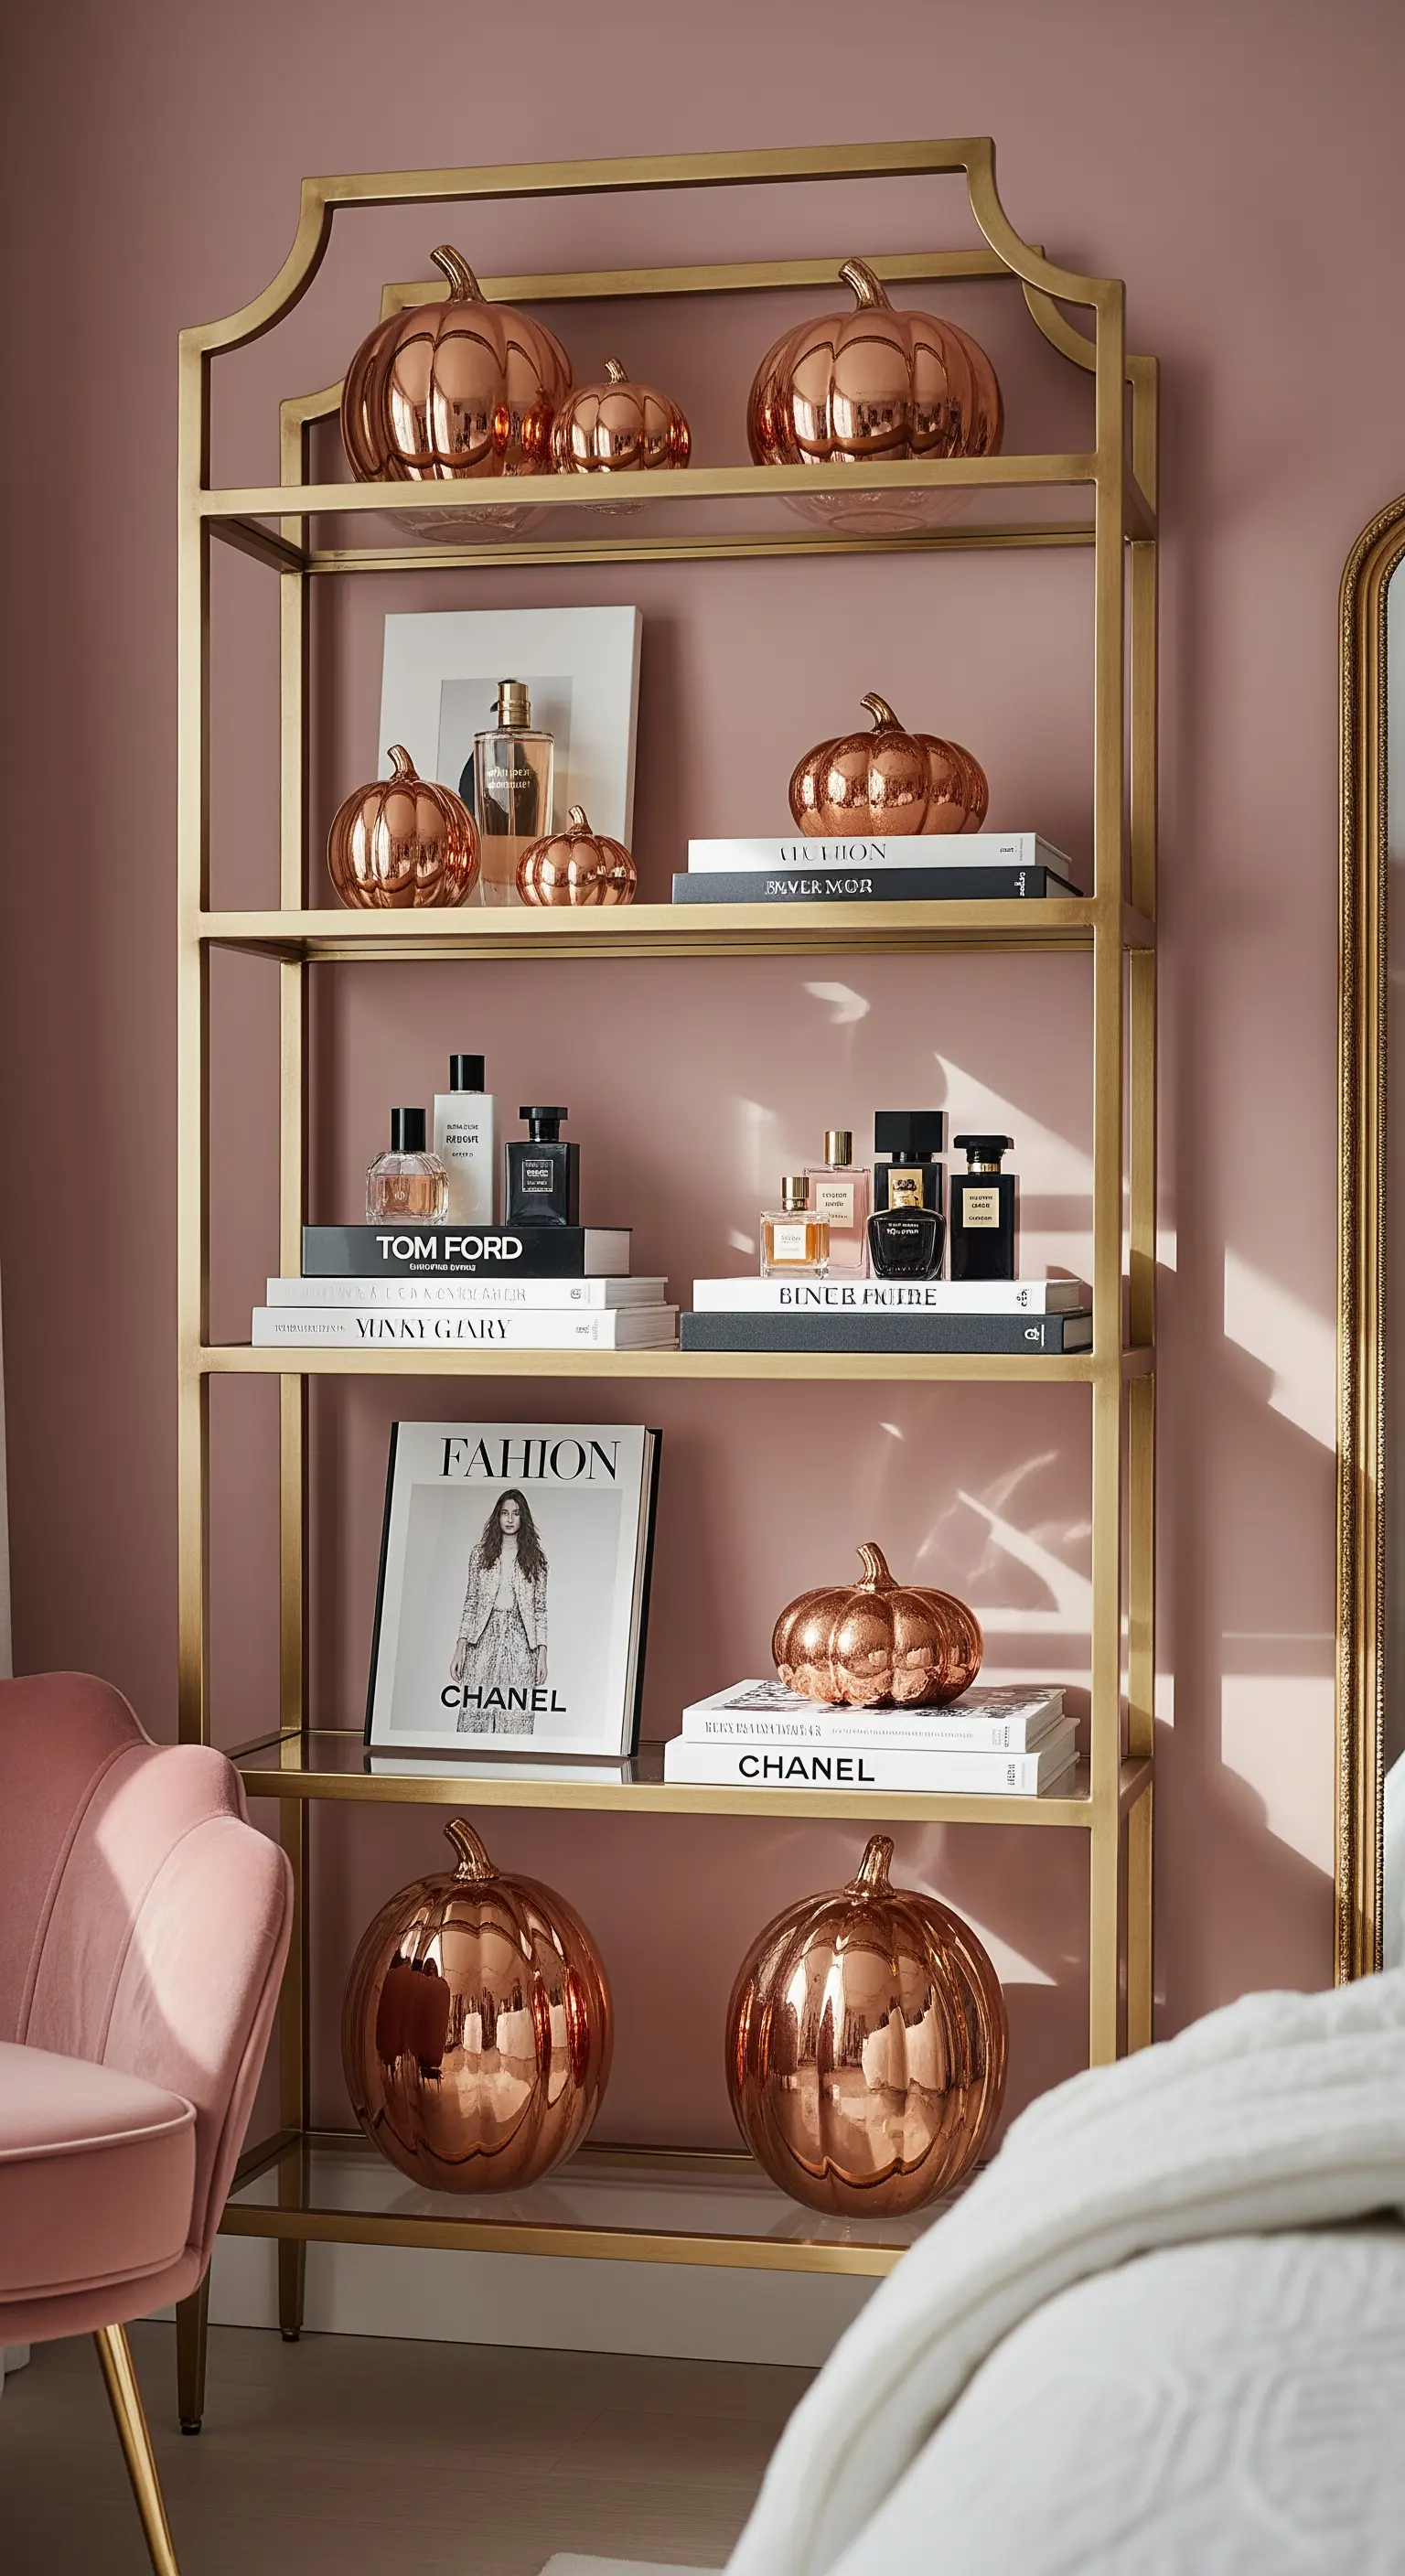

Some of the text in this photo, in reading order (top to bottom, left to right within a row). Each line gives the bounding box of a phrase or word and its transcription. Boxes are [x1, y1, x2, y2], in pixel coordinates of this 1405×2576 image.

[376, 1236, 523, 1260] TOM FORD
[439, 1437, 622, 1481] FAHION
[441, 1685, 567, 1712] CHANEL
[738, 1755, 875, 1782] CHANEL
